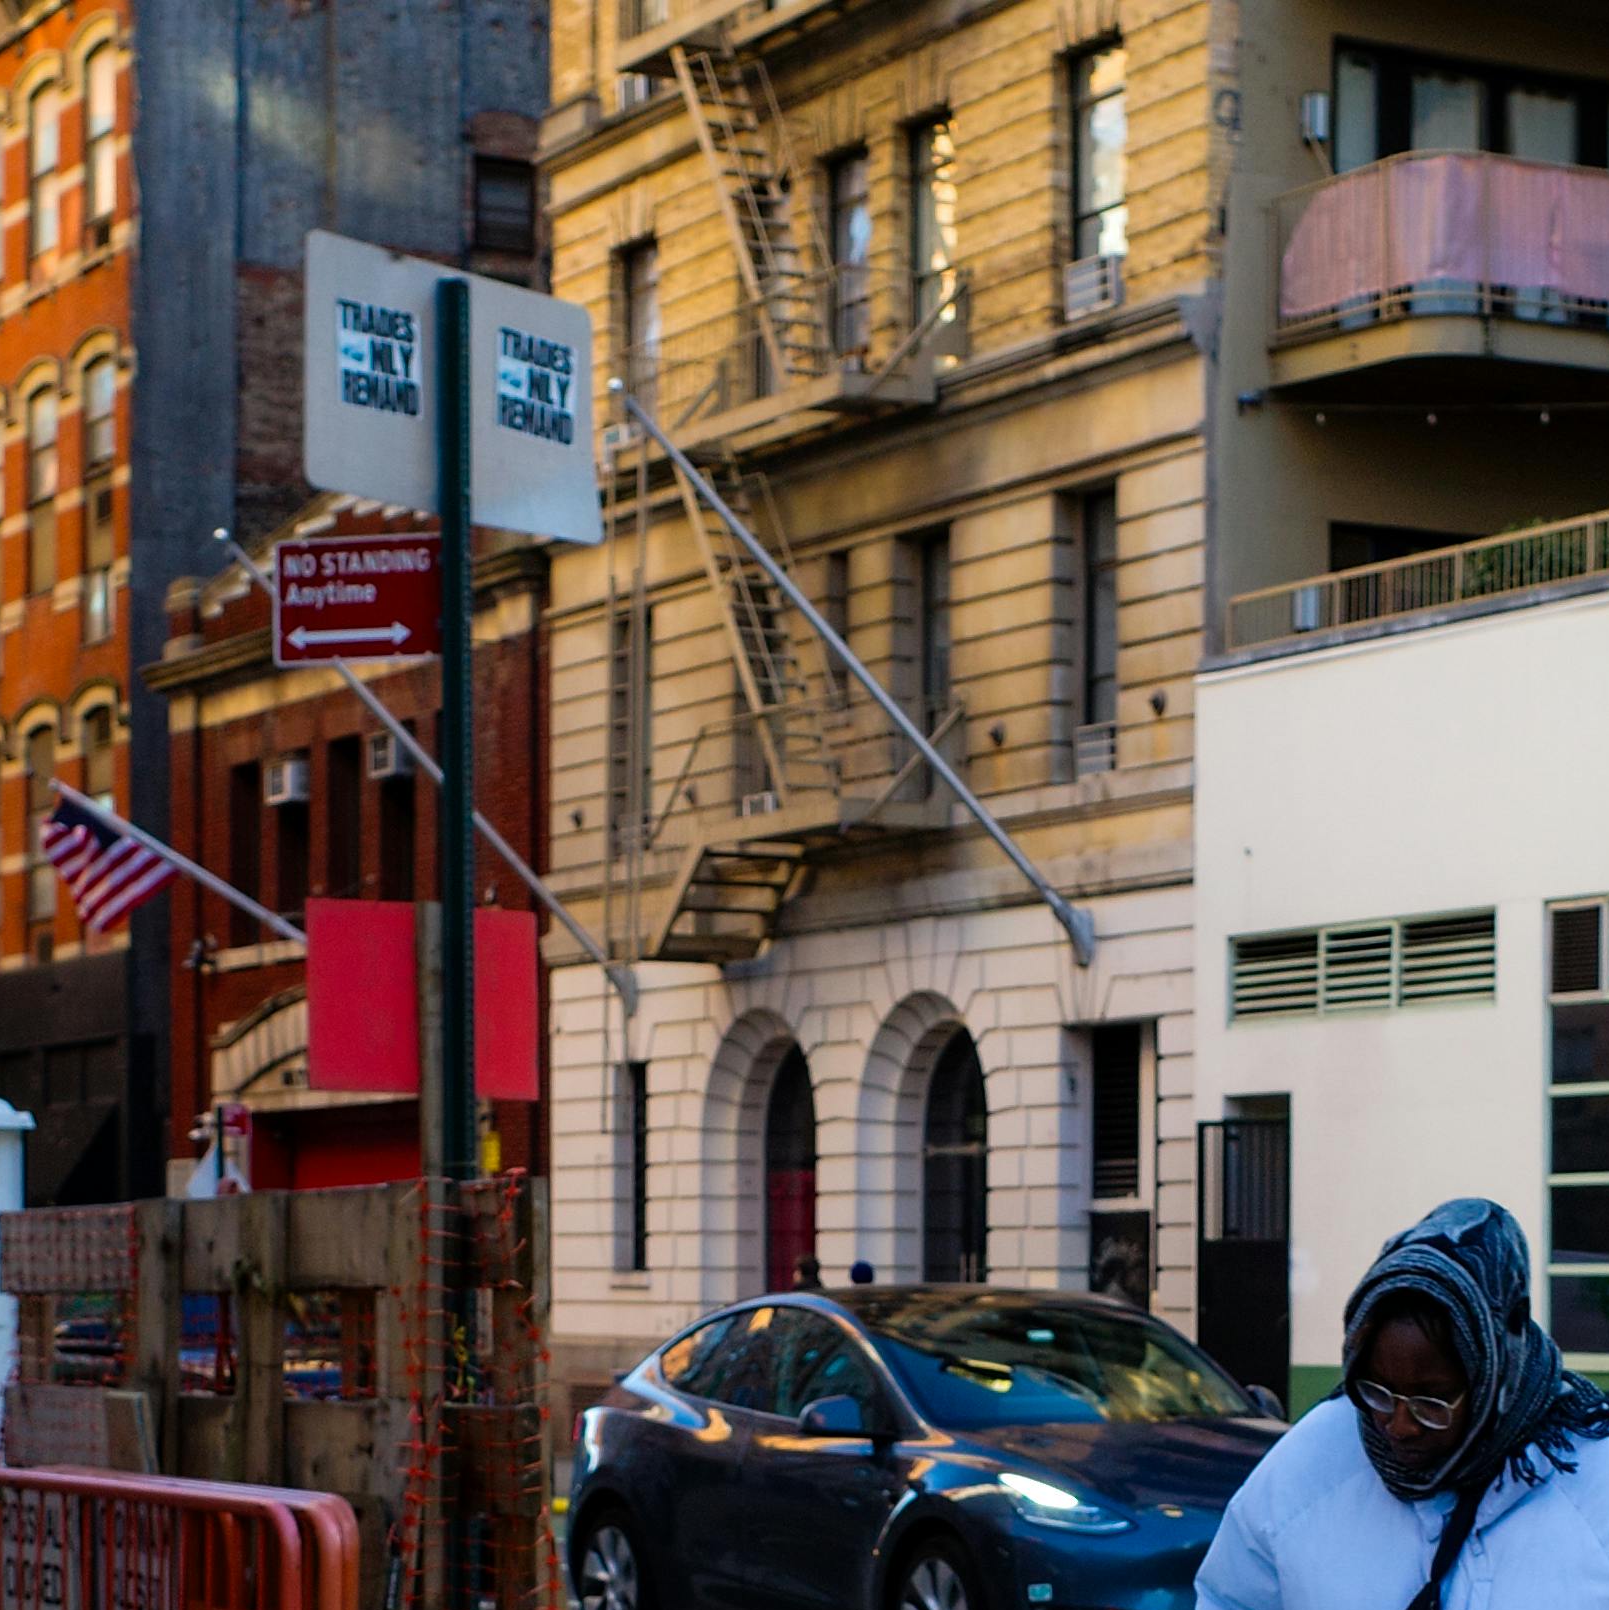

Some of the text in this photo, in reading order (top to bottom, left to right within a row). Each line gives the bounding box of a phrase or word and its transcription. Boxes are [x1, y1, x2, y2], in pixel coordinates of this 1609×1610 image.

[283, 547, 432, 578] NO STANDING
[285, 580, 378, 610] Anytime
